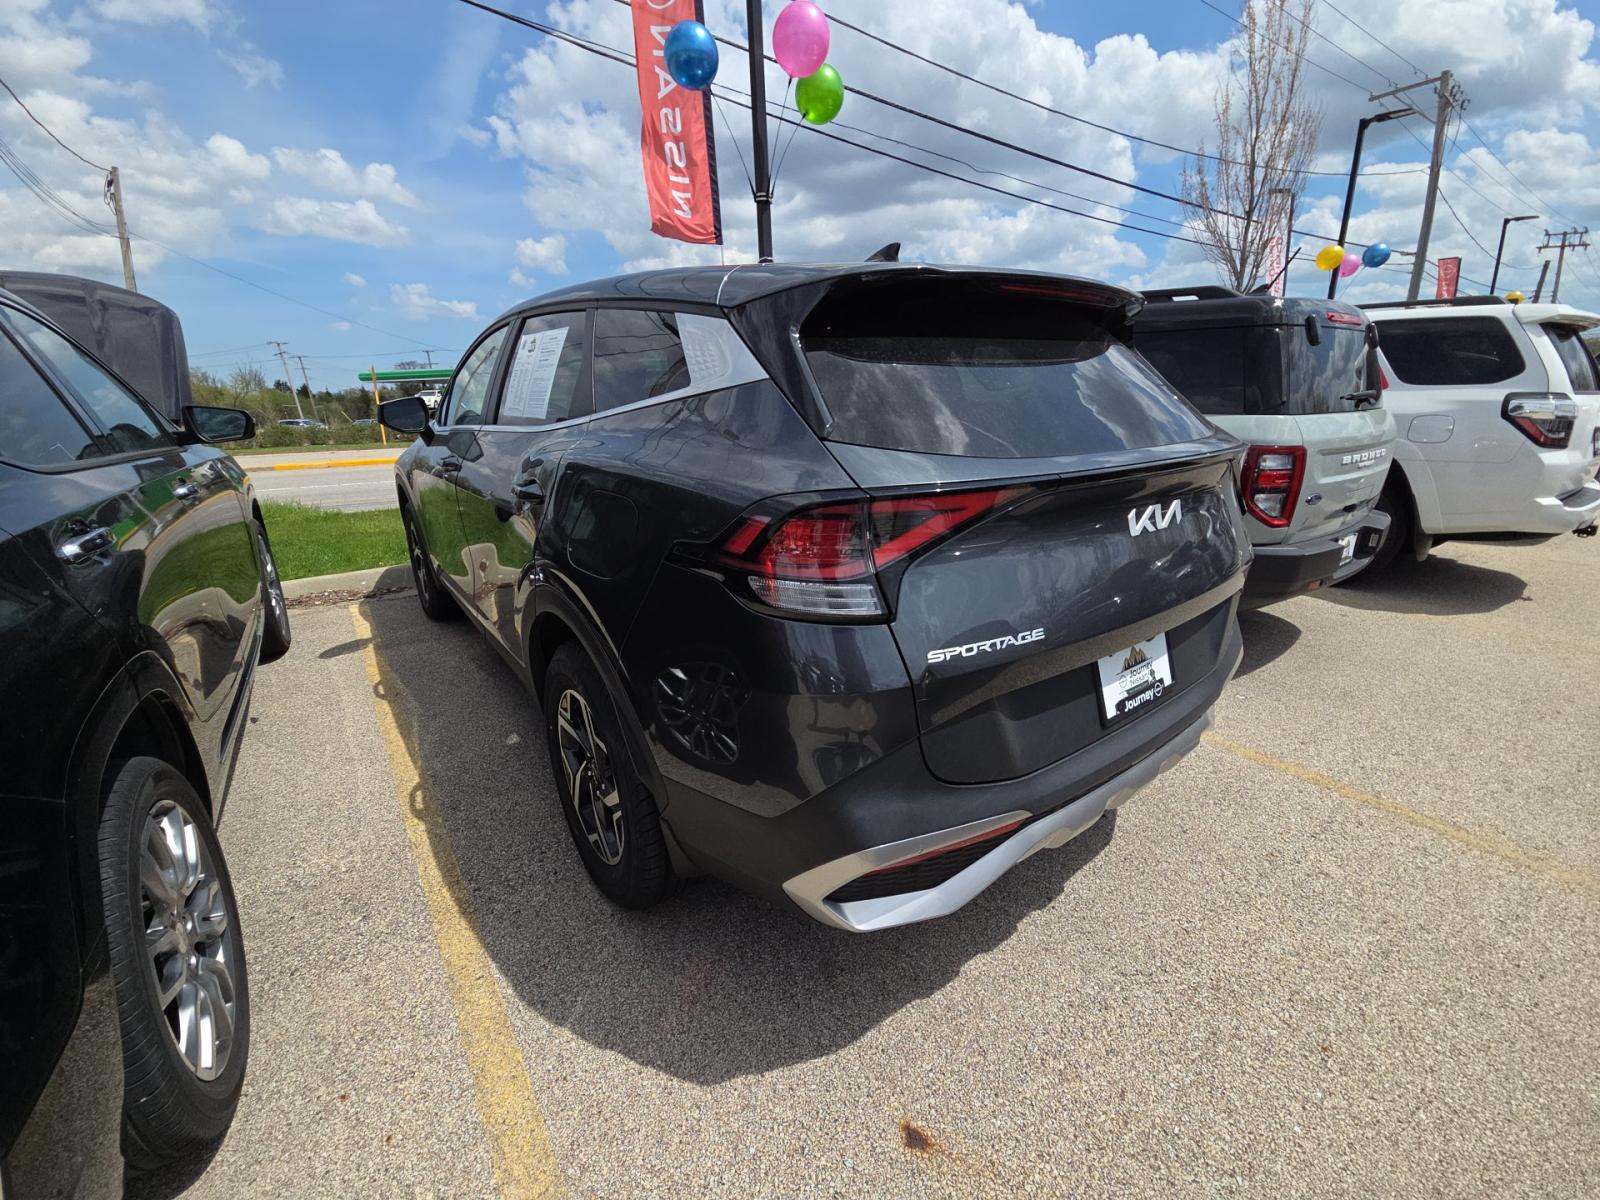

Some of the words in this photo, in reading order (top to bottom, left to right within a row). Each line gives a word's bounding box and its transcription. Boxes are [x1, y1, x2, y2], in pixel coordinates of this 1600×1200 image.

[1342, 448, 1386, 464] BRONCO
[1127, 499, 1183, 537] KIA
[927, 627, 1046, 663] SPORTAGE
[1124, 689, 1155, 712] Journey
